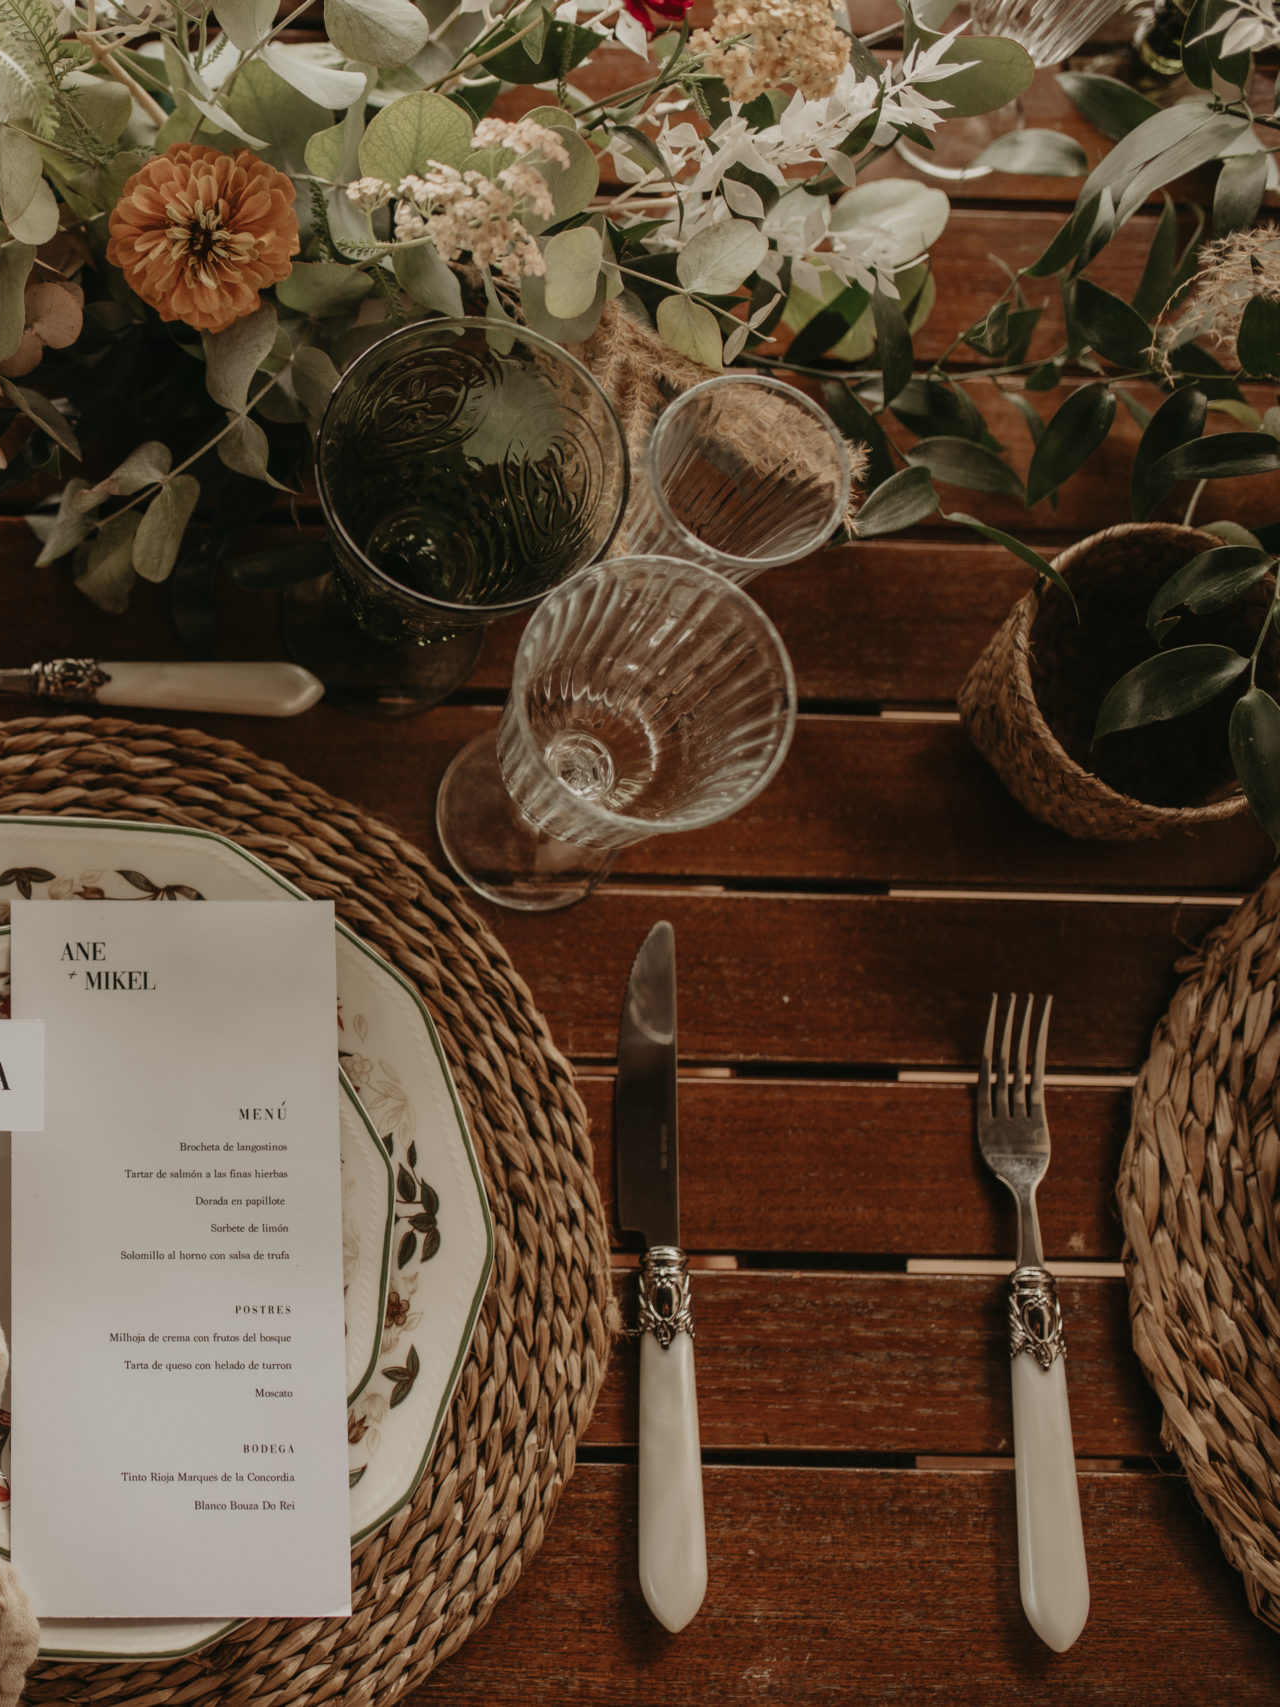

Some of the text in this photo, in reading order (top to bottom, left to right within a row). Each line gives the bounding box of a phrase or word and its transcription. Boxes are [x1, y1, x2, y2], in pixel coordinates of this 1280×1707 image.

[60, 941, 107, 961] ANE
[84, 970, 157, 990] MIKEL
[238, 1100, 288, 1120] MENÚ
[179, 1141, 288, 1153] Brocheta de langostinos
[124, 1168, 154, 1178] Tartar
[155, 1168, 168, 1178] de
[169, 1168, 203, 1178] salmón
[213, 1168, 227, 1178] las
[229, 1168, 252, 1178] finas
[254, 1168, 289, 1178] hierbas
[194, 1195, 229, 1205] Dorada
[245, 1195, 286, 1207] papillote
[210, 1223, 289, 1232] Sorbete de limón
[120, 1249, 291, 1260] Solomillo al horno con salsa de trufa
[234, 1304, 292, 1314] POSTRES
[109, 1332, 146, 1343] Milhoja
[148, 1332, 160, 1342] de
[212, 1332, 241, 1342] frutos
[242, 1332, 257, 1342] del
[259, 1332, 292, 1344] bosque
[123, 1360, 150, 1369] Tarta
[151, 1360, 163, 1370] de
[165, 1362, 193, 1372] queso
[194, 1362, 212, 1370] con
[214, 1359, 246, 1370] helado
[247, 1359, 260, 1370] de
[255, 1387, 294, 1397] Moscato
[243, 1443, 295, 1453] BODEGA
[120, 1471, 148, 1481] Tinto
[150, 1471, 175, 1483] Rioja
[220, 1471, 233, 1482] de
[234, 1471, 245, 1481] la
[246, 1471, 296, 1482] Concordia
[194, 1499, 296, 1510] Blanco Bouza Do Rei
